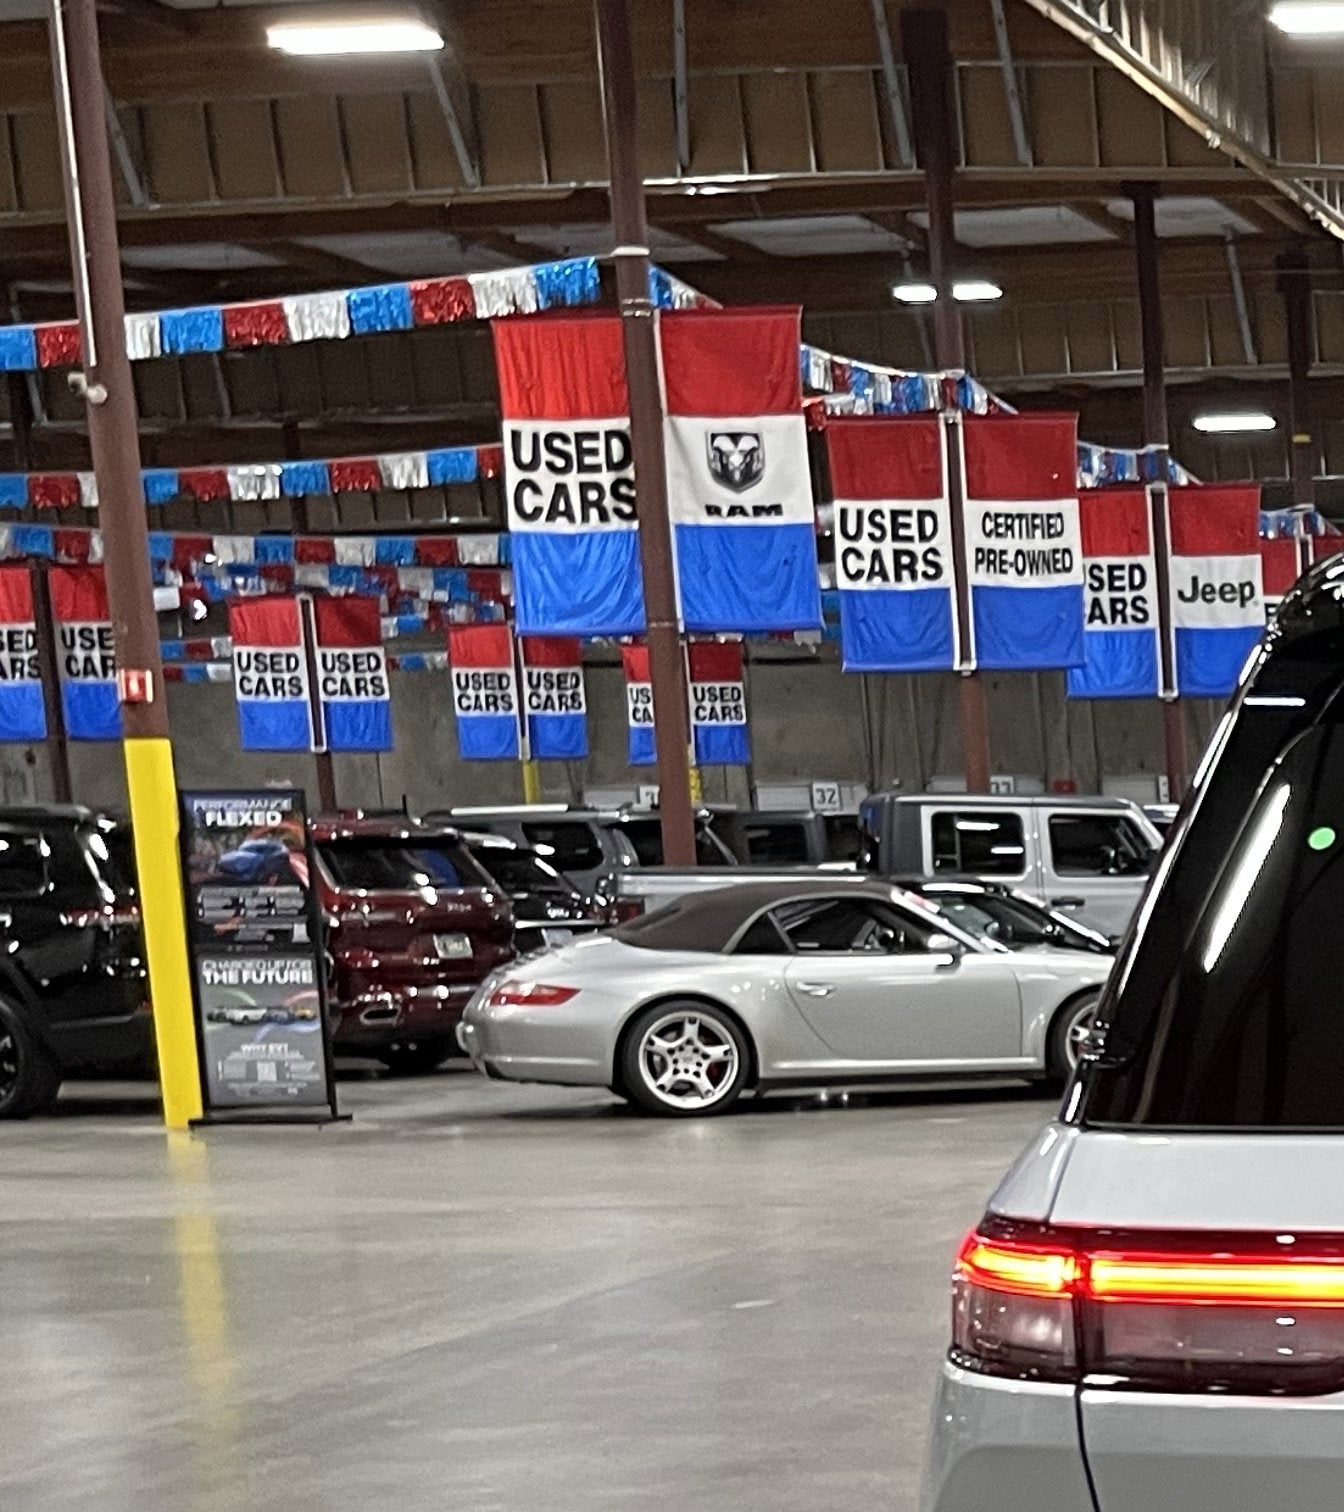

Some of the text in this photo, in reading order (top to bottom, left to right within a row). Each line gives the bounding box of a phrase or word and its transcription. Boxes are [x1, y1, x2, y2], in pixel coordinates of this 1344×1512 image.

[511, 429, 633, 474] USED
[513, 478, 638, 524] CARS
[704, 503, 784, 518] RAM
[839, 508, 939, 543] USED
[981, 511, 1065, 539] CERTIFIED
[841, 547, 943, 583] CARS
[974, 547, 1074, 577] PRE-OWNED
[1086, 563, 1148, 593] SED
[1177, 575, 1256, 608] Jeep
[1087, 595, 1150, 625] ARS
[61, 626, 113, 651] USE
[65, 654, 116, 679] CAR
[237, 652, 300, 674] USED
[321, 652, 382, 674] USED
[239, 676, 303, 697] CARS
[322, 676, 386, 698] CARS
[456, 672, 511, 691] USED
[527, 671, 580, 691] USED
[457, 693, 514, 712] CARS
[528, 691, 583, 711] CARS
[629, 687, 652, 705] US
[693, 686, 741, 703] USED
[632, 706, 654, 723] CA
[694, 704, 744, 722] CARS
[205, 811, 283, 827] FLEXED
[203, 969, 313, 985] THE FUTURE
